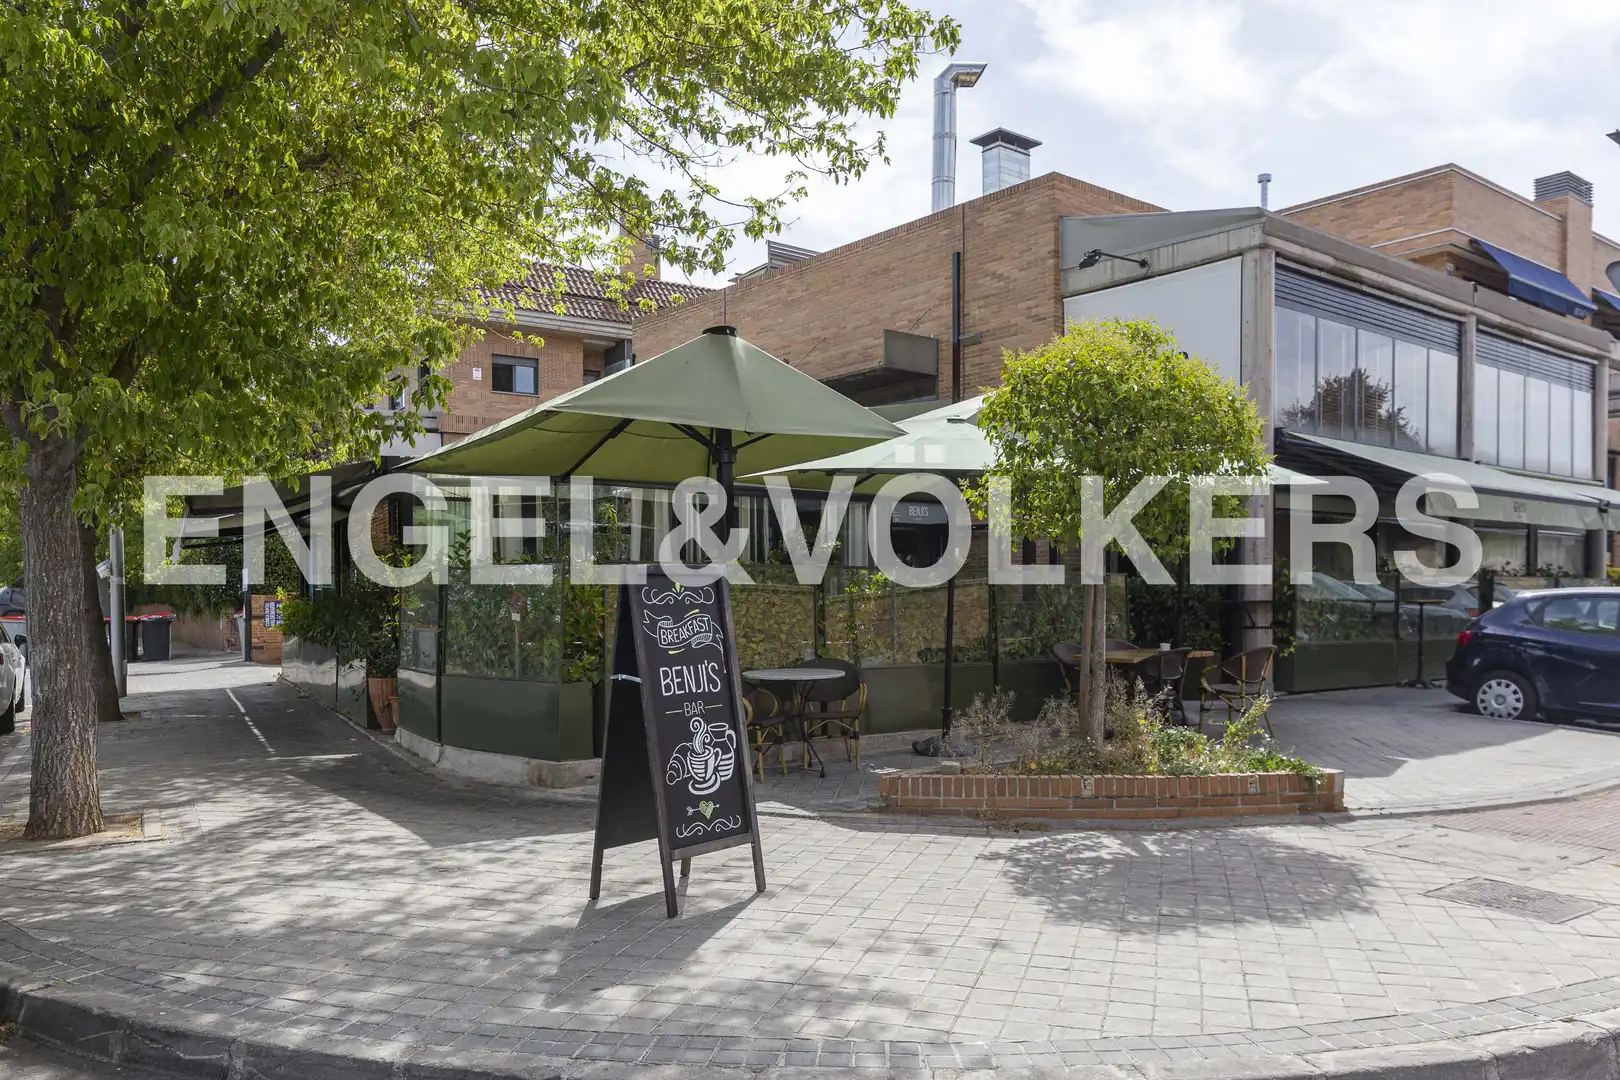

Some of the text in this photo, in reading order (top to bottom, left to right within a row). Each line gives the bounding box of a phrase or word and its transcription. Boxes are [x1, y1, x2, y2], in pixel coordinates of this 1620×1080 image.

[909, 505, 929, 517] BENJI'S
[660, 617, 709, 645] BREAKFAST
[659, 660, 721, 696] BENJI'S
[684, 700, 706, 717] BAR
